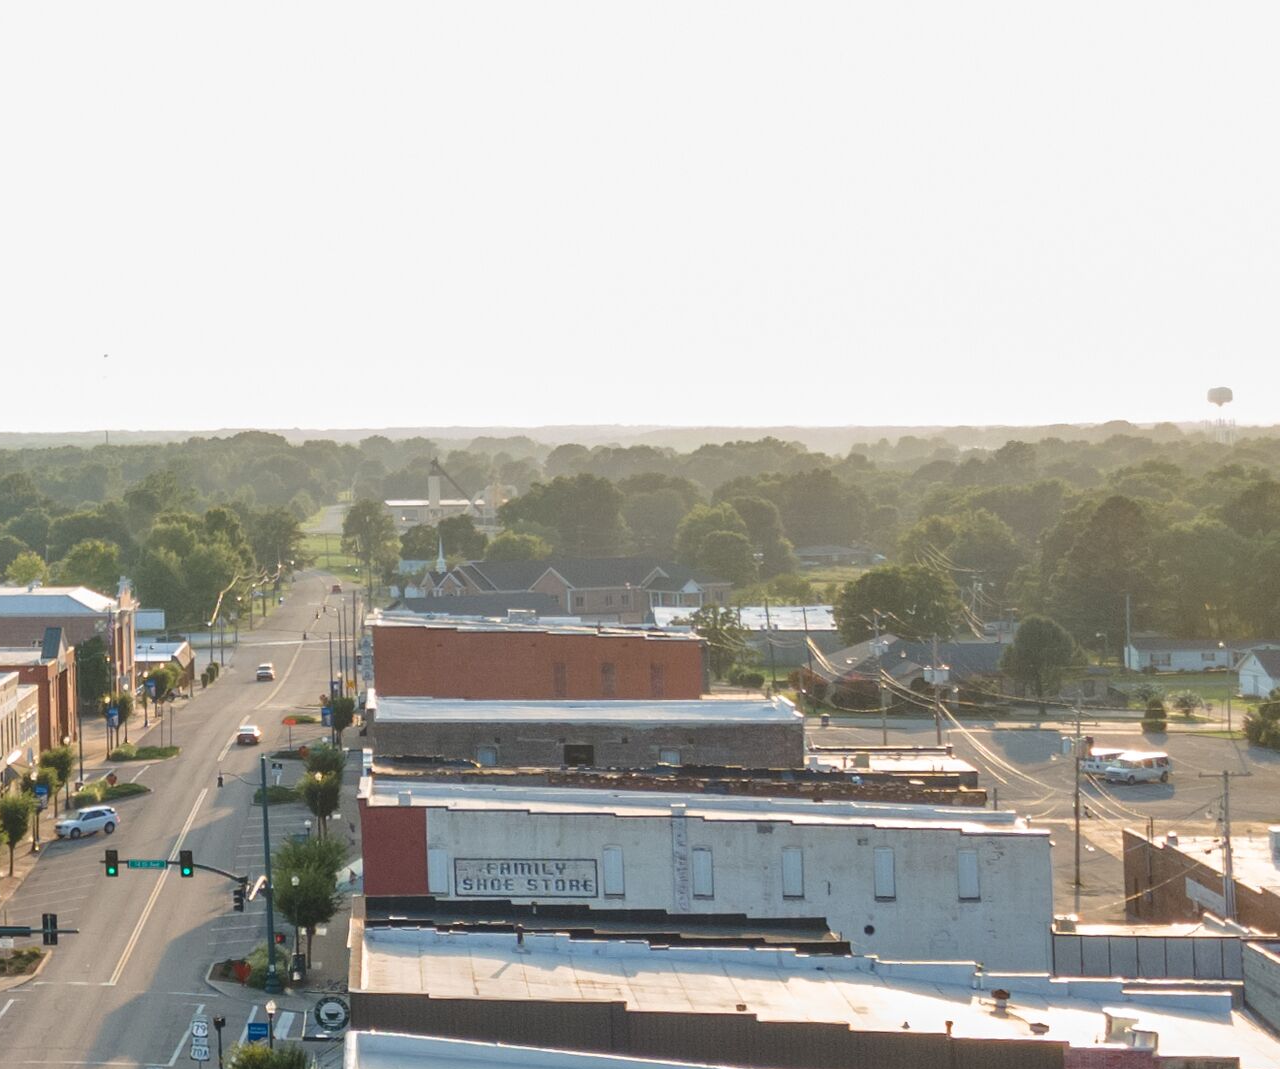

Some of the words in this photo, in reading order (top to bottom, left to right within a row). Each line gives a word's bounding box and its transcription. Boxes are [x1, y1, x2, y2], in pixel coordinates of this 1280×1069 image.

[486, 862, 567, 876] FAMILY
[462, 879, 514, 891] SHOE
[527, 879, 594, 892] STORE
[193, 1024, 206, 1034] 79
